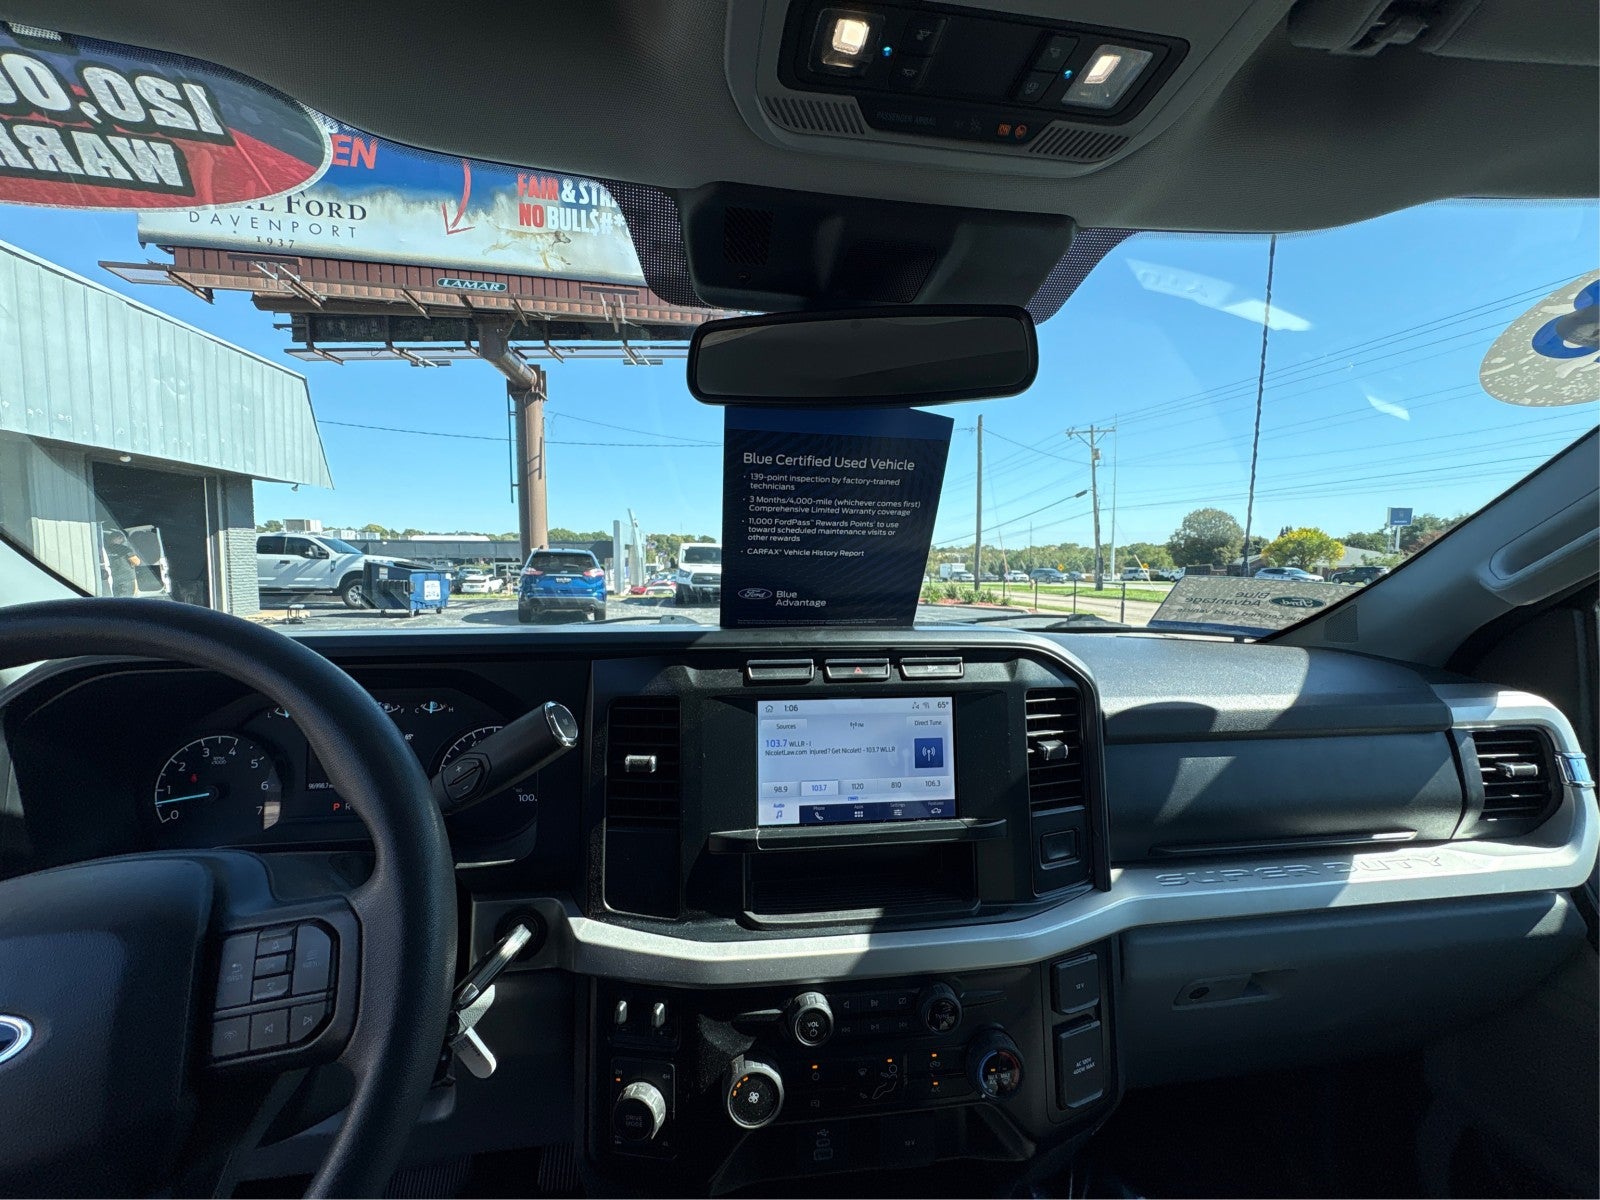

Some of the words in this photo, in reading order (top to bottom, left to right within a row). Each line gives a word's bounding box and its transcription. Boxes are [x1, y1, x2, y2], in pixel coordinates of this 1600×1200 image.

[517, 172, 559, 201] FAIR
[285, 192, 367, 221] FORD
[518, 203, 545, 228] NO
[189, 210, 357, 239] DAVENPORT
[256, 235, 295, 249] 1937
[442, 279, 500, 291] LAMAR
[743, 452, 773, 465] Blue
[775, 454, 831, 468] Certified
[834, 457, 867, 469] Used
[870, 458, 916, 471] Vehicle
[750, 473, 788, 483] 139-point
[789, 475, 831, 485] inspection
[832, 477, 842, 485] by
[842, 476, 900, 486] factory-trained
[750, 482, 795, 491] technicians
[834, 499, 876, 508] (whichever
[903, 501, 921, 509] first)
[749, 505, 810, 514] Comprehensive
[841, 507, 876, 516] Warranty
[815, 520, 849, 528] Rewards
[748, 526, 776, 534] toward
[777, 527, 817, 535] scheduled
[783, 549, 811, 557] Vehicle
[811, 550, 838, 558] History
[776, 590, 798, 599] Blue
[775, 599, 827, 608] Advantage
[784, 704, 799, 712] 1:06
[765, 739, 788, 748] 103.7
[202, 748, 211, 758] 3
[228, 747, 236, 756] 4
[178, 761, 187, 772] 2
[250, 758, 259, 769] 5
[260, 781, 269, 791] 6
[773, 785, 788, 793] 98.9
[169, 809, 179, 820] 0
[256, 805, 263, 816] 7
[1155, 865, 1321, 887] SUPER
[1323, 855, 1442, 874] DUTY
